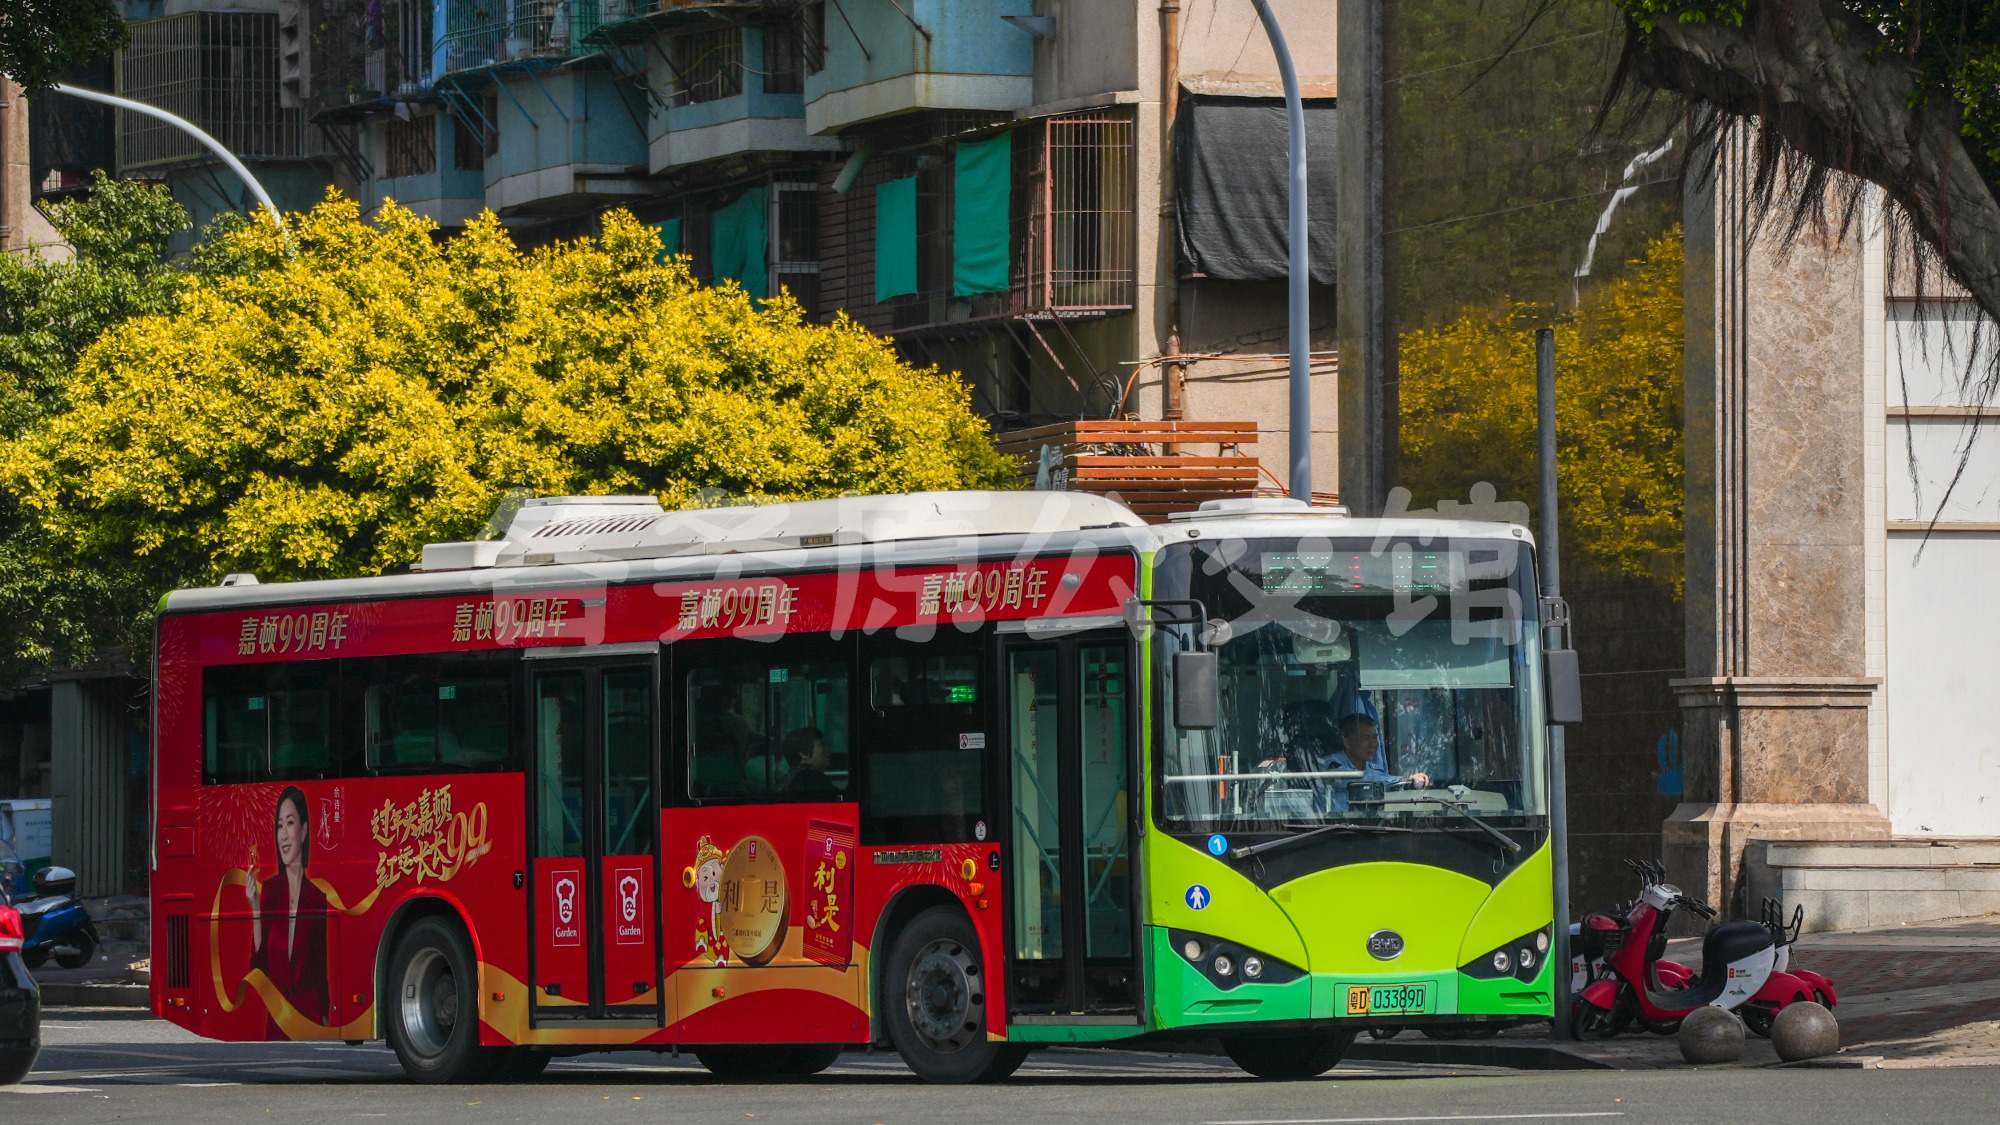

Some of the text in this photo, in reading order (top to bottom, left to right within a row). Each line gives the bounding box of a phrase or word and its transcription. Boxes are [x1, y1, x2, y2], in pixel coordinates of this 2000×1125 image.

[920, 567, 1050, 617] 嘉顿99周年
[451, 598, 570, 643] 嘉顿99周年
[676, 584, 800, 631] 嘉顿99周年
[237, 612, 350, 656] 嘉顿99周年
[370, 783, 453, 847] 过年买嘉顿
[1213, 837, 1222, 852] 1
[990, 854, 999, 868] 上
[514, 873, 523, 886] 下
[812, 860, 841, 933] 利是
[555, 926, 578, 938] Garden
[619, 925, 641, 936] Garden
[1371, 938, 1401, 953] BYD
